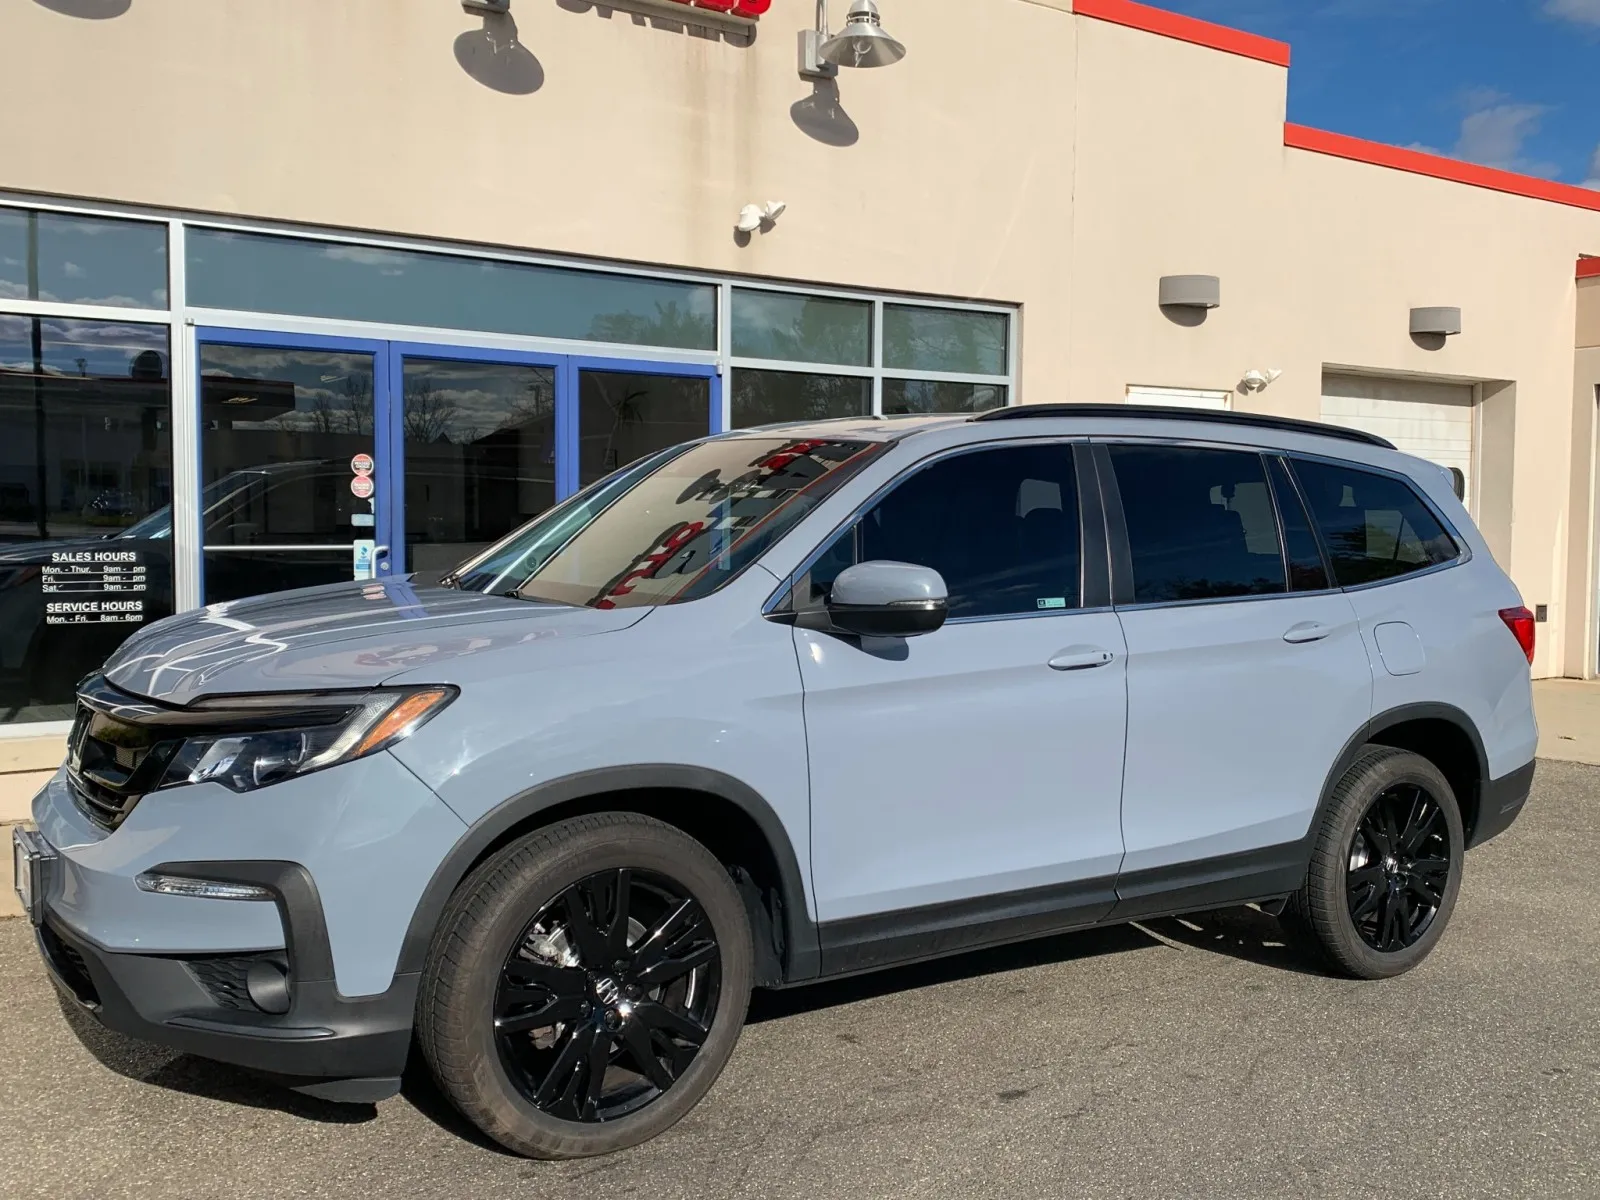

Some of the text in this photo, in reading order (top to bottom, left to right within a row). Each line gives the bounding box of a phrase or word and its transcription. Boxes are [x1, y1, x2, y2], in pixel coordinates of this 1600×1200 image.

[52, 552, 136, 561] SALES HOURS
[46, 601, 143, 612] SERVICE HOURS
